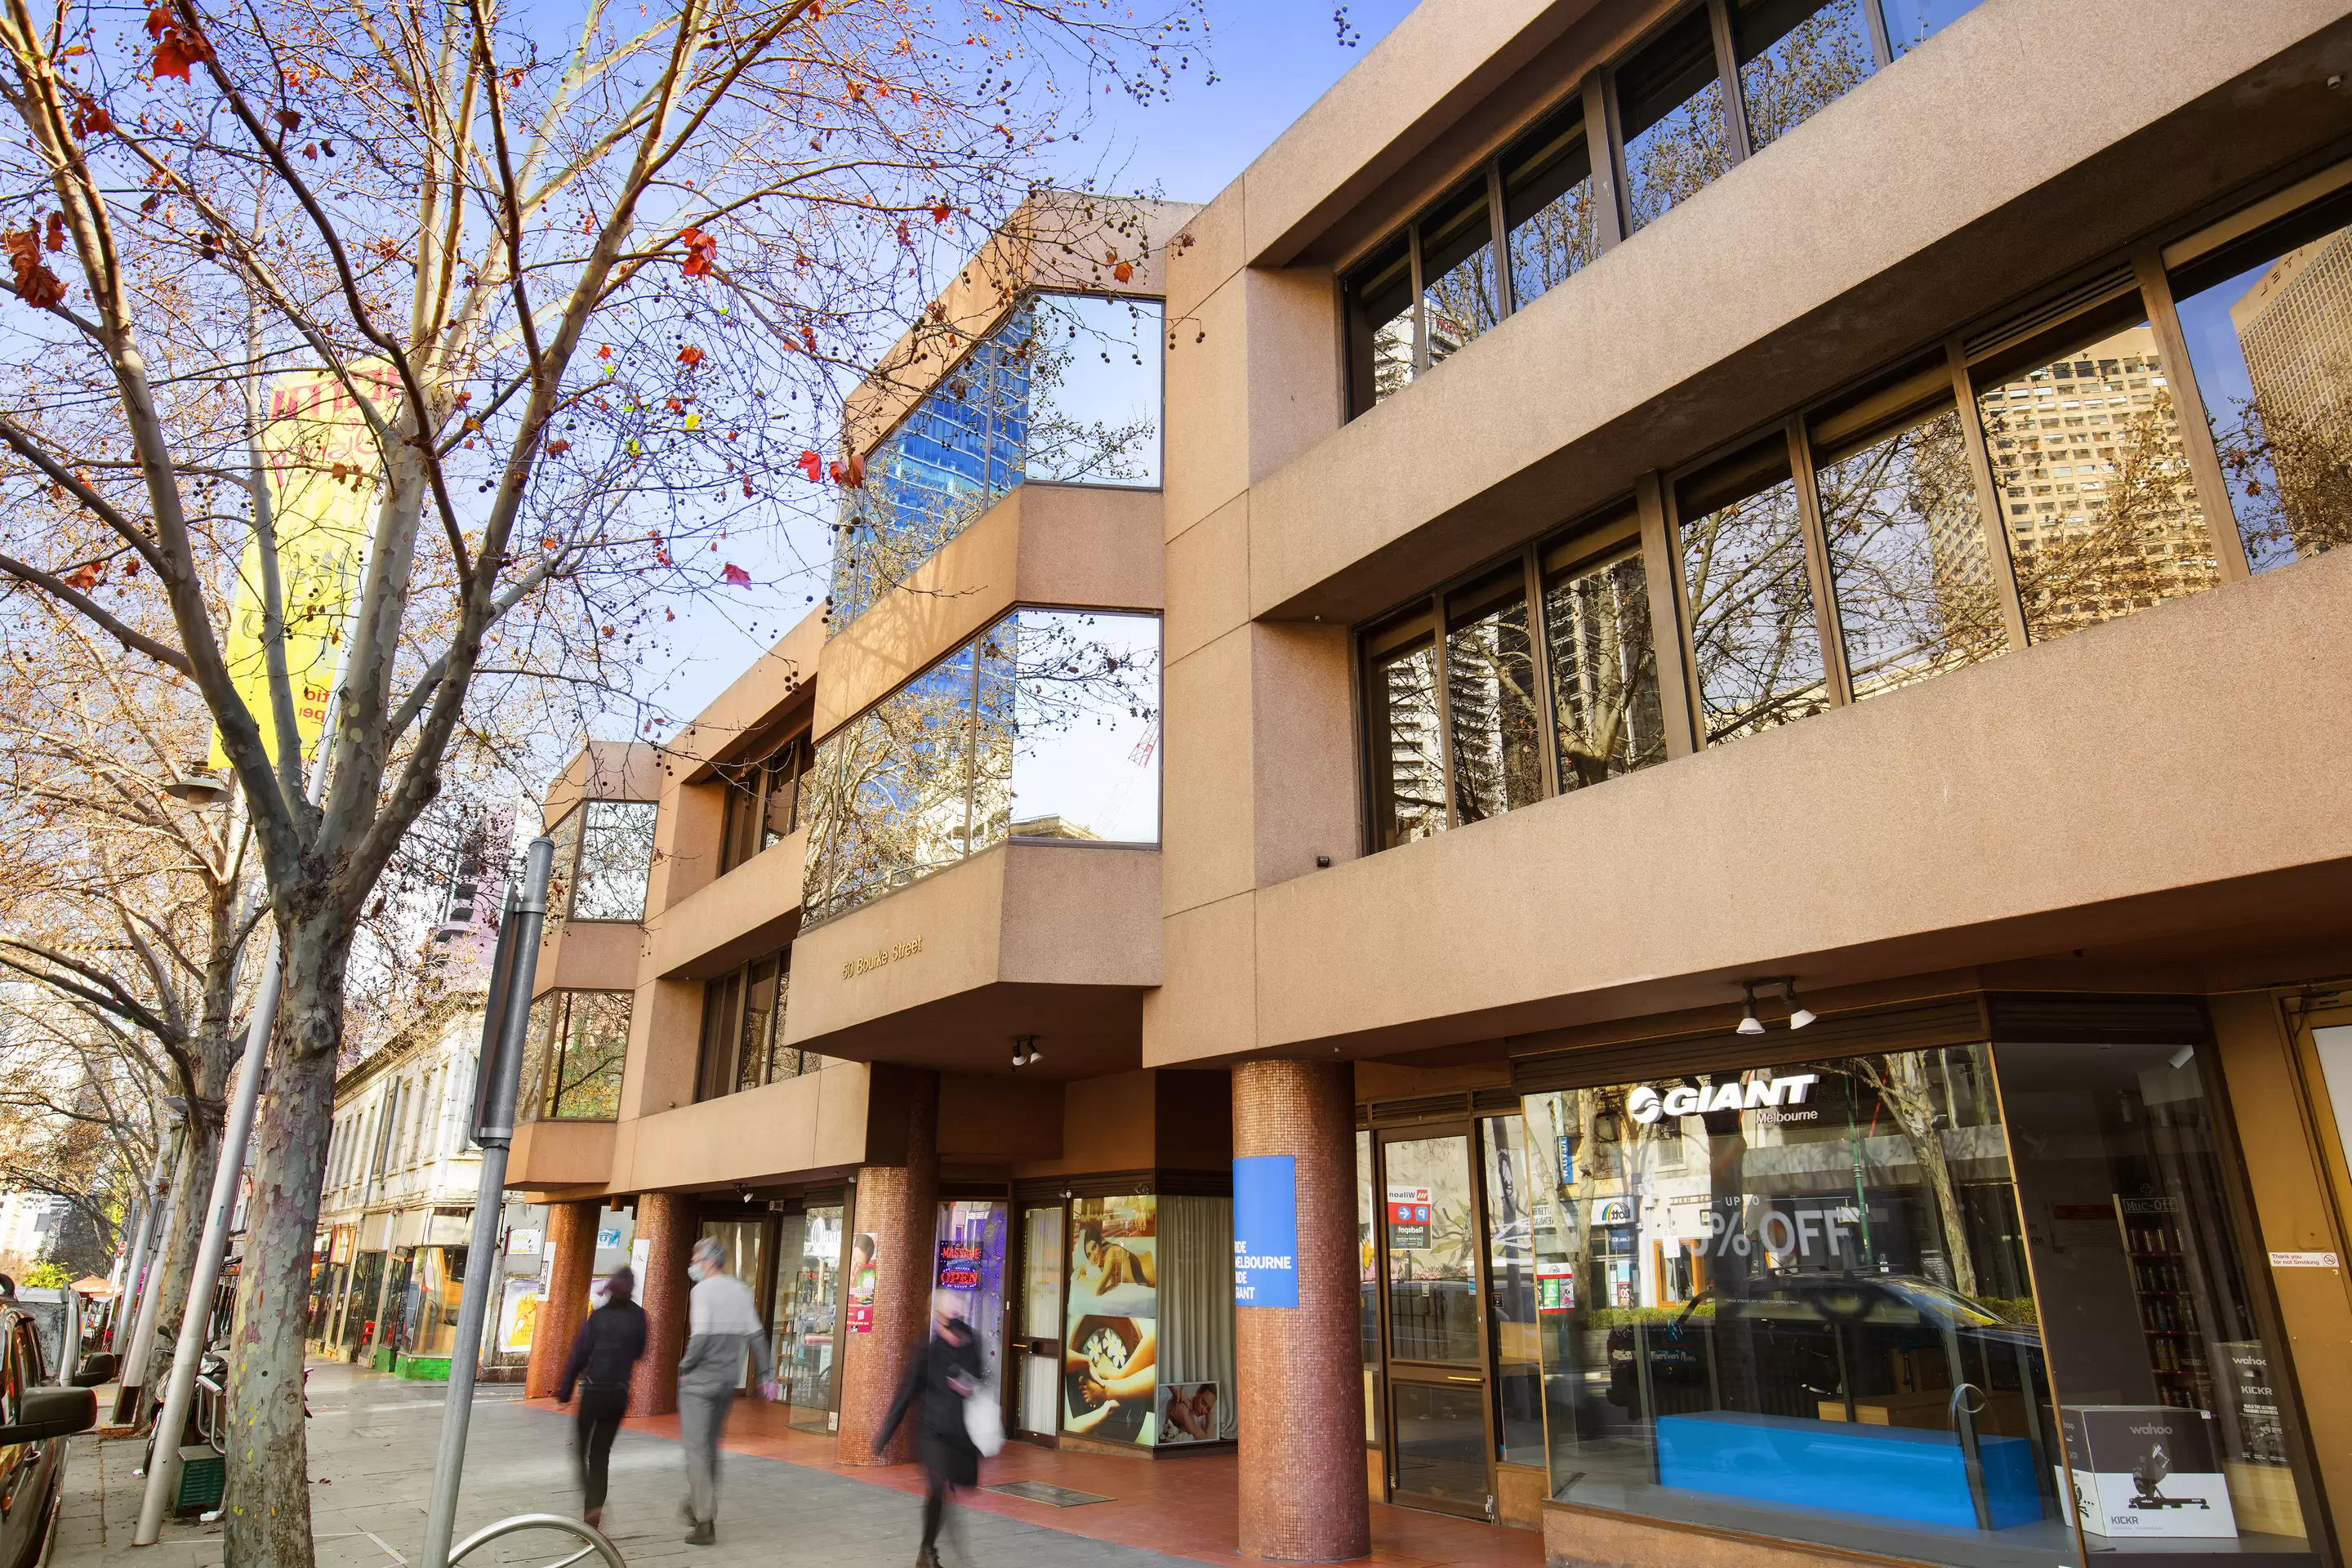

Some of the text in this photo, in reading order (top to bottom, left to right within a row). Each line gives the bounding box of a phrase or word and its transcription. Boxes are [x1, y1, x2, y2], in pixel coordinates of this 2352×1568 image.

[843, 934, 922, 980] 50 Bourke Street
[1663, 1073, 1820, 1116] GIANT
[1757, 1110, 1819, 1125] Melbourne
[1725, 1196, 1740, 1206] UP
[2125, 1200, 2175, 1212] Muc-Off
[1760, 1209, 1850, 1257] OFF
[942, 1247, 980, 1259] MASSAGE
[941, 1272, 979, 1284] OPEN
[2241, 1386, 2273, 1396] KICKR
[2129, 1423, 2173, 1435] wahoo
[2111, 1516, 2139, 1525] KICKR
